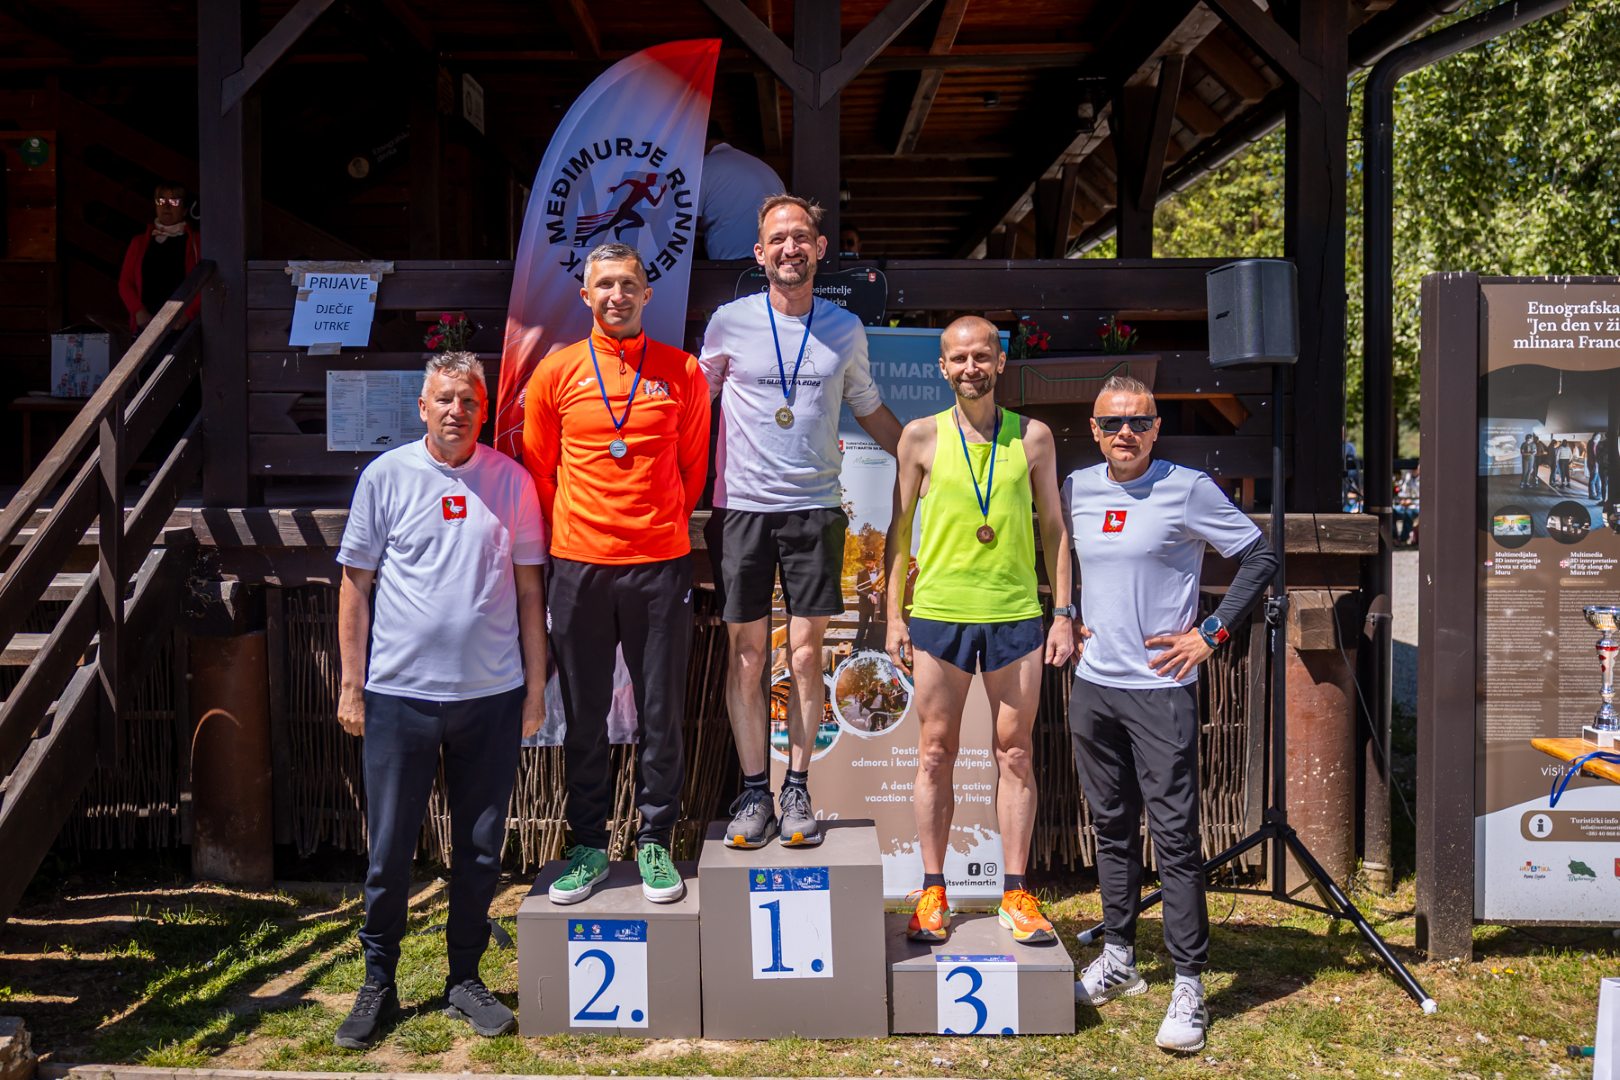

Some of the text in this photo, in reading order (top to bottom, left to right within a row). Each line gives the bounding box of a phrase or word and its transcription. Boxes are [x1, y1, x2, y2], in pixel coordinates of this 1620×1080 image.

[546, 138, 668, 244] MEĐIMURJE
[309, 277, 369, 290] PRIJAVE
[812, 285, 852, 296] osjetitelje
[316, 303, 354, 315] DJEČJE
[1527, 301, 1620, 318] Etnografska
[314, 321, 351, 331] UTRKE
[1527, 318, 1557, 335] "Jen
[1561, 318, 1590, 331] den
[1594, 322, 1603, 331] v
[1513, 335, 1574, 349] mlinara
[891, 384, 941, 400] MURI
[851, 758, 888, 767] odmora
[881, 782, 888, 790] A
[961, 781, 992, 790] active
[865, 794, 907, 803] vacation
[965, 794, 992, 804] living
[945, 879, 997, 887] itsvetimartin
[759, 899, 824, 973] 1.
[574, 949, 644, 1022] 2.
[943, 966, 1014, 1034] 3.
